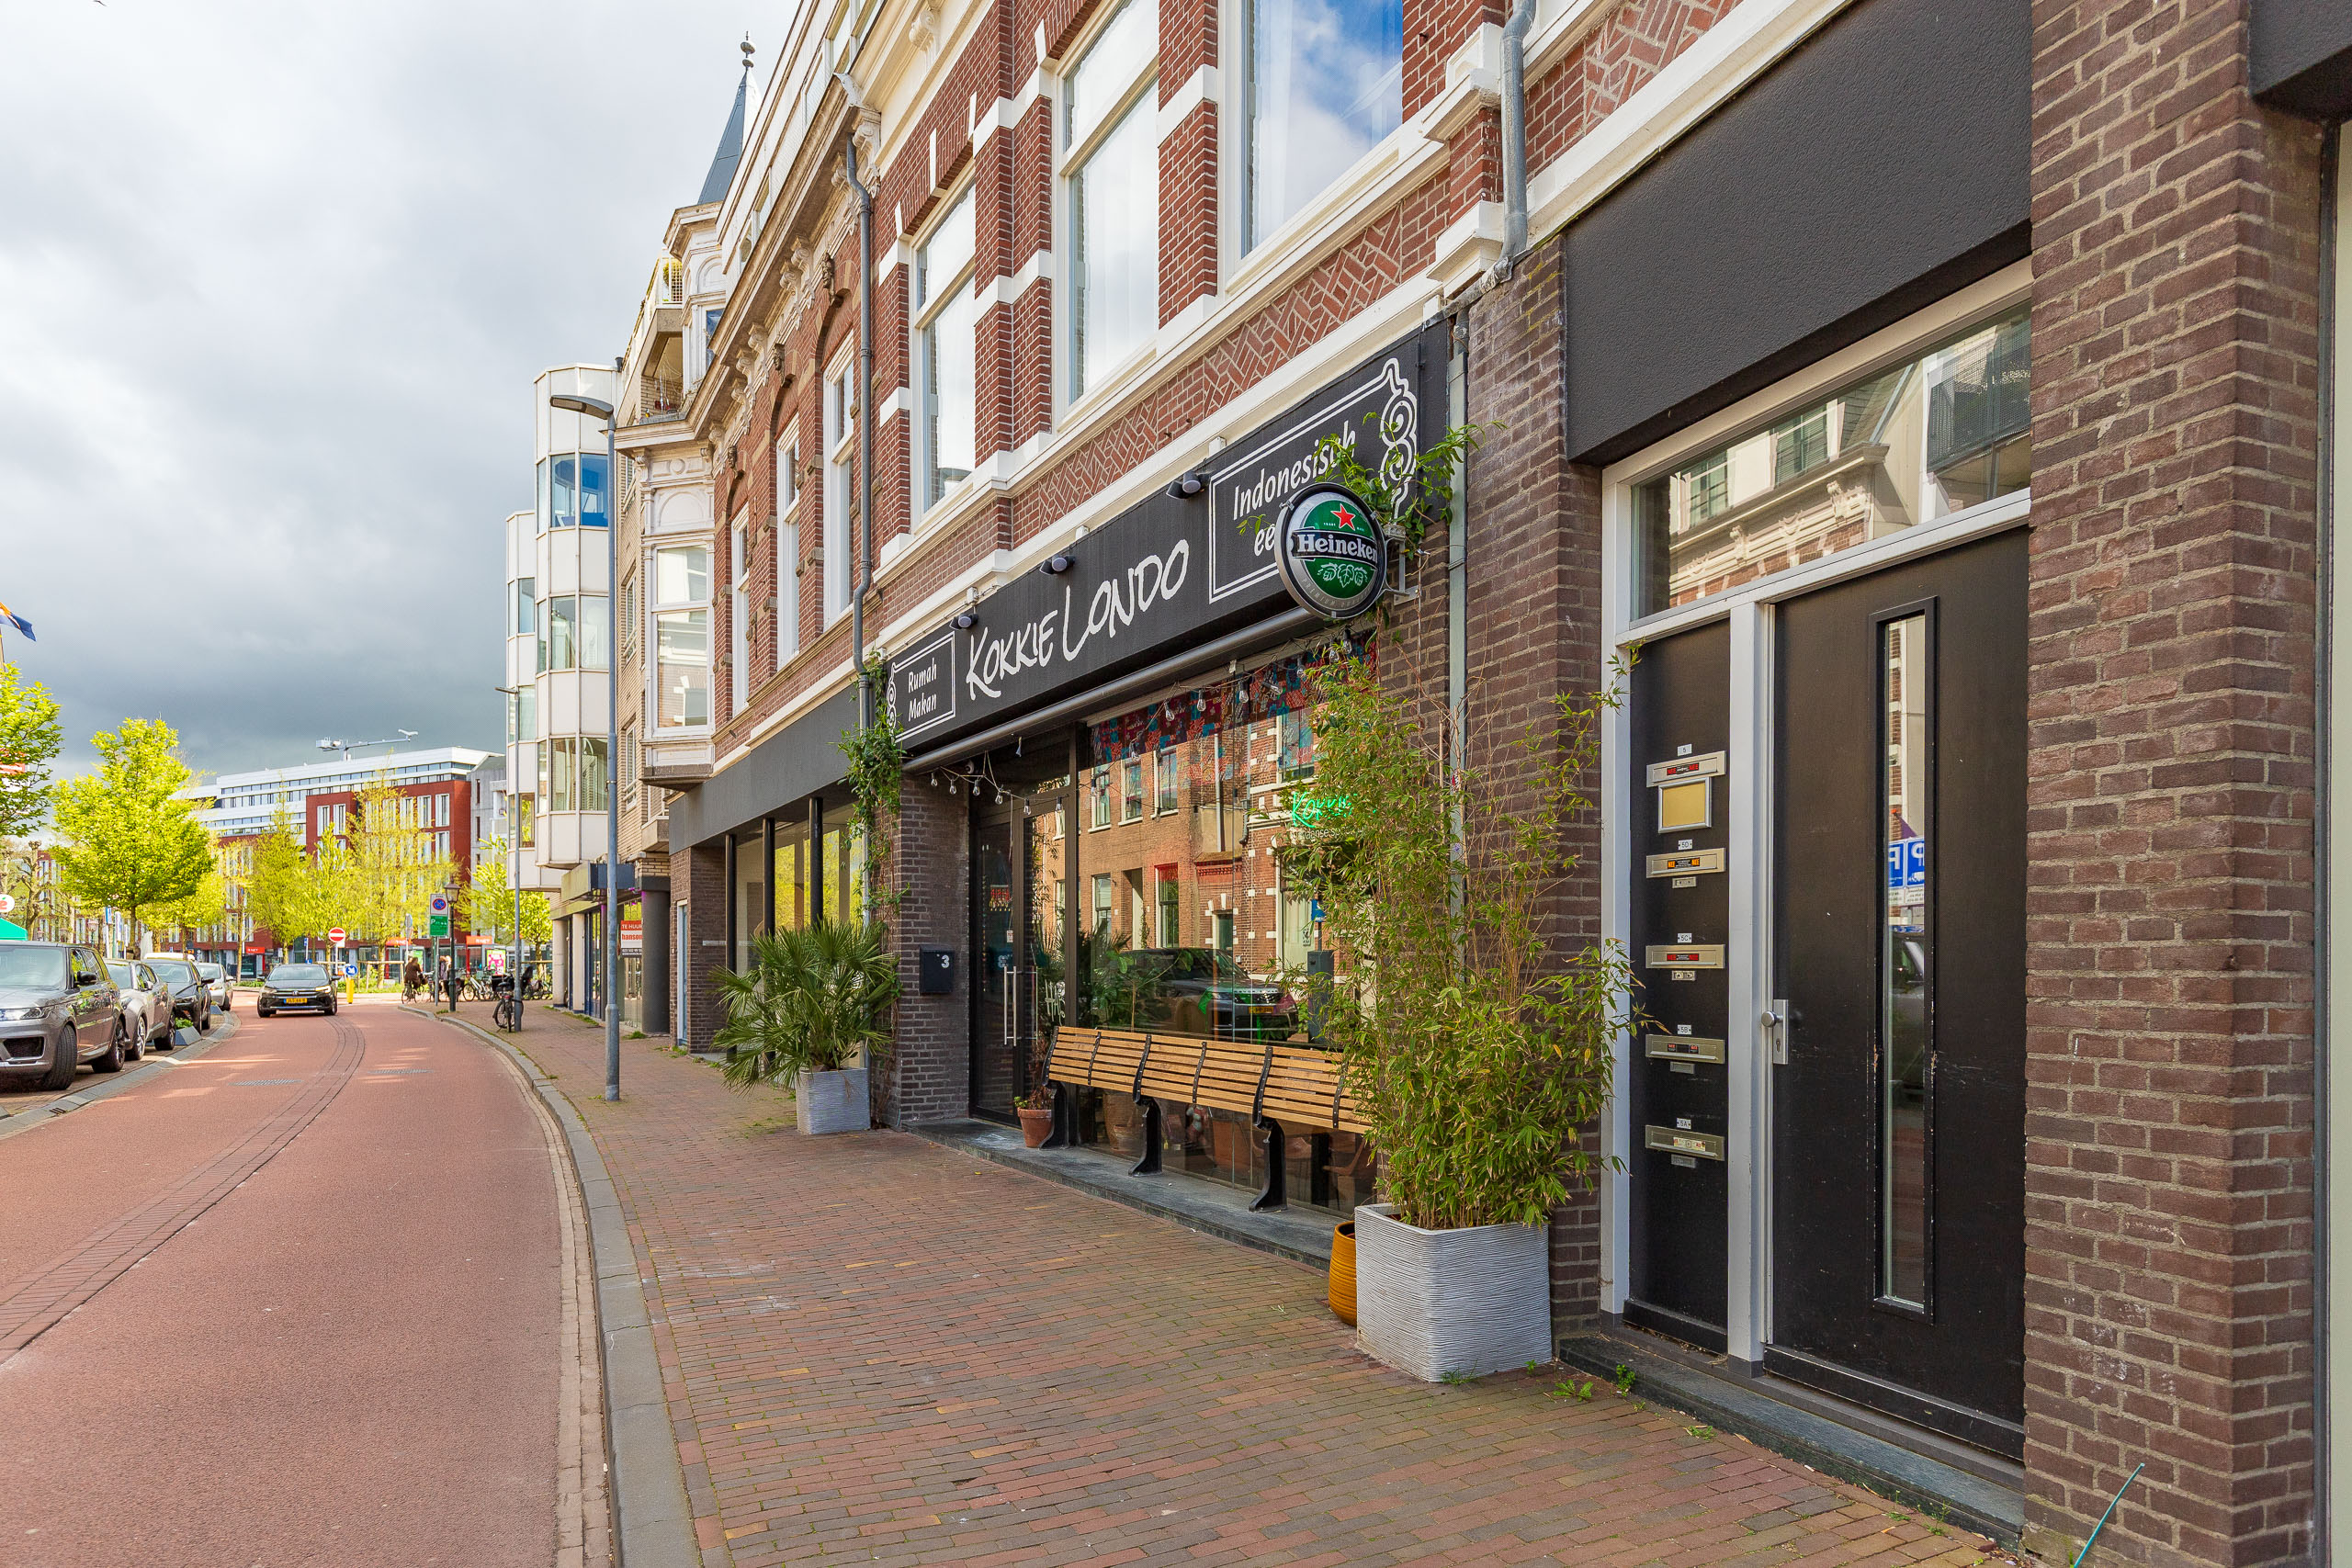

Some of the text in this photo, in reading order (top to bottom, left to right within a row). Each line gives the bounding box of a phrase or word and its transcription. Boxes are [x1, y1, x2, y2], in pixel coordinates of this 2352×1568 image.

[1296, 534, 1378, 564] Heineken
[966, 539, 1190, 701] KOKKIE LONDO
[908, 657, 937, 694] Rumah
[908, 692, 937, 722] Makan
[941, 954, 950, 968] 3
